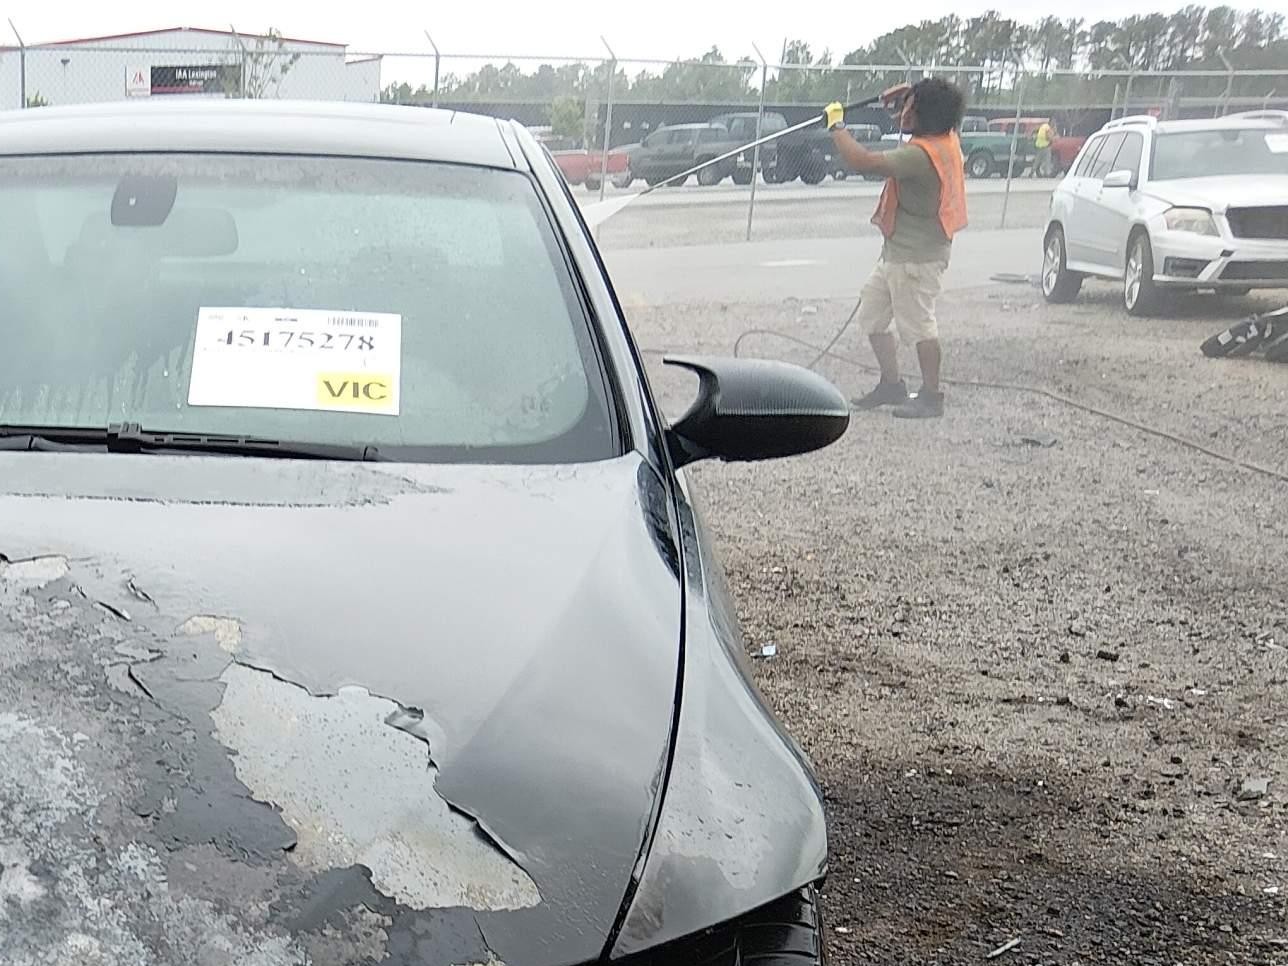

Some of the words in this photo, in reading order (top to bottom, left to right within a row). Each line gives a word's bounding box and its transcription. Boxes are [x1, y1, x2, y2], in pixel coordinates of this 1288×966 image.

[175, 68, 187, 80] IAA
[217, 329, 375, 351] 45175278
[323, 380, 387, 400] VIC
